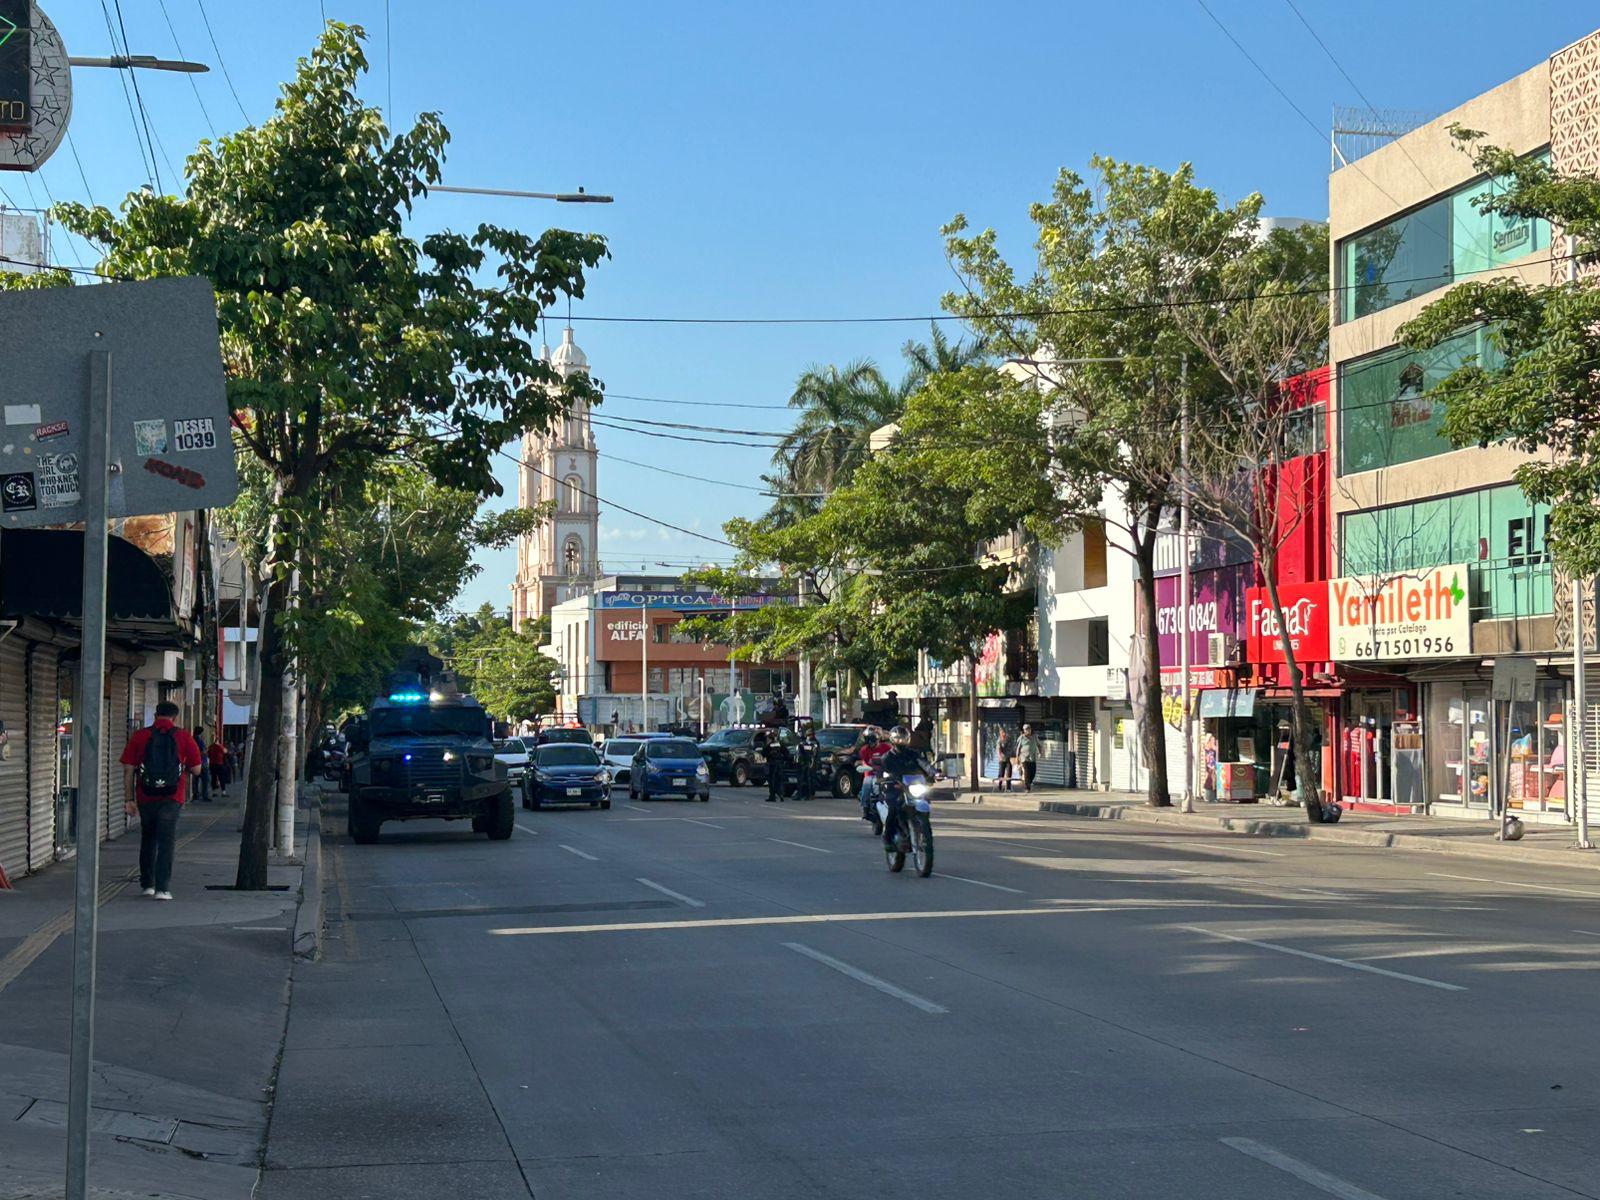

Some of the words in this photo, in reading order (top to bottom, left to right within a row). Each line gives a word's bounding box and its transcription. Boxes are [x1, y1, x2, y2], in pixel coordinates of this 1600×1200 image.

[174, 418, 214, 434] DESER
[176, 431, 214, 449] 1039
[630, 594, 708, 606] OPTICA
[1333, 571, 1452, 627] Yamileth
[607, 620, 649, 631] edificio
[611, 630, 645, 641] ALFA
[1355, 636, 1454, 657] 6671501956
